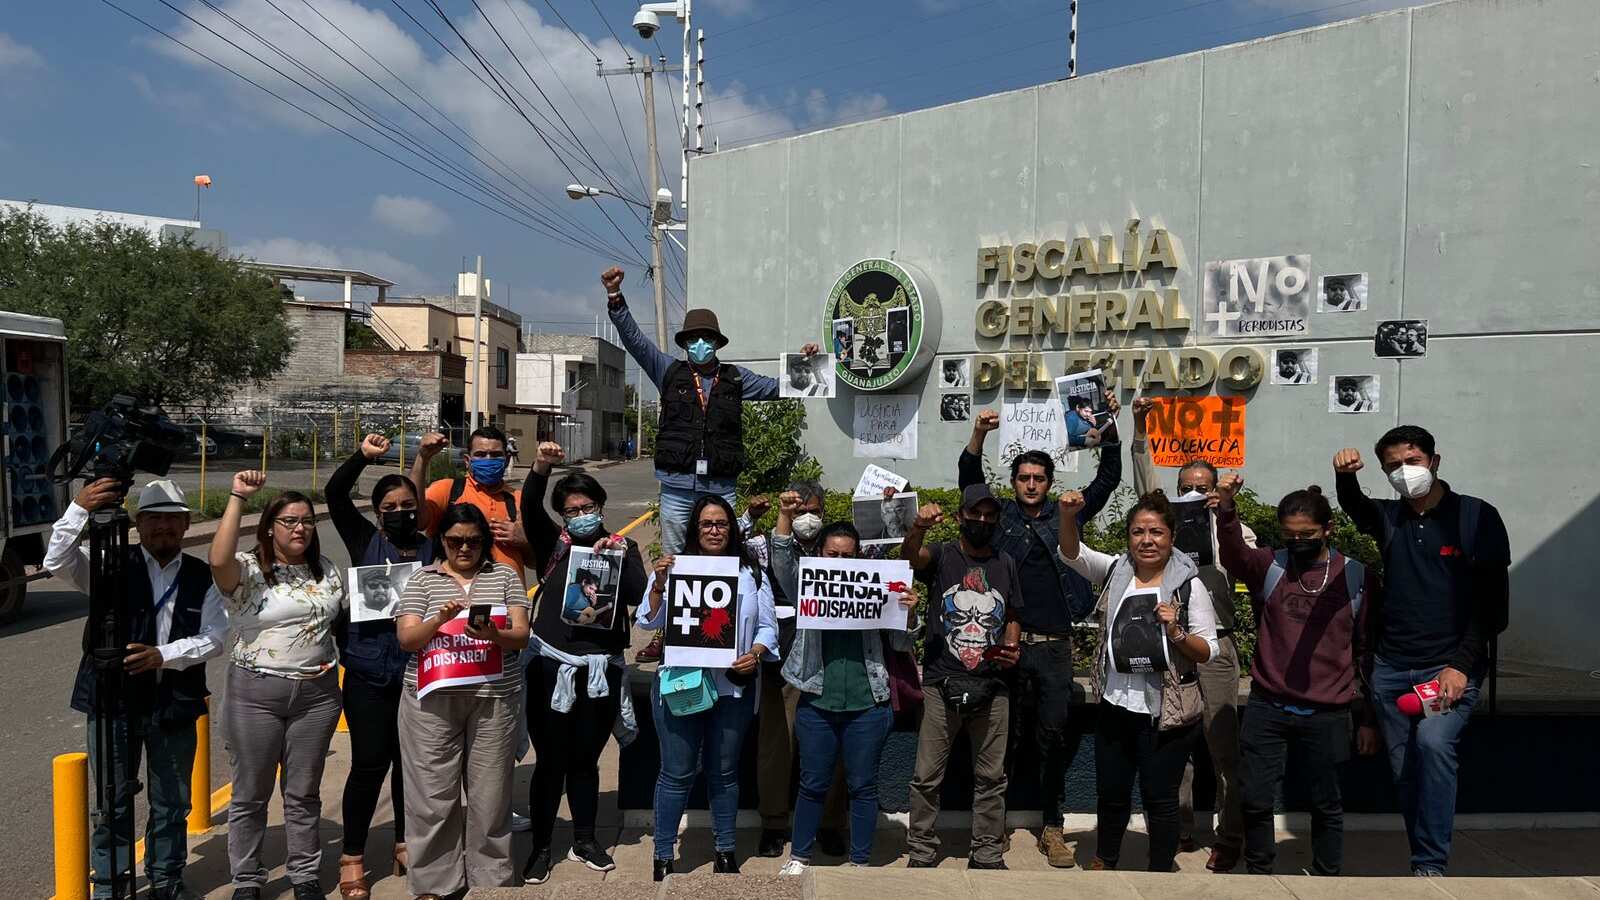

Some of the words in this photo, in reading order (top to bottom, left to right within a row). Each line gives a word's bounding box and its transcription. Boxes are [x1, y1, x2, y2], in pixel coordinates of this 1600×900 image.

[977, 219, 1178, 283] FISCALÍA
[976, 288, 1191, 338] GENERAL
[1238, 319, 1305, 333] PERIODISTAS
[841, 368, 901, 388] GUANAJUATO
[974, 353, 1052, 391] DEL
[1065, 347, 1265, 391] ESTADO
[1069, 382, 1097, 394] JUSTICIA
[1022, 426, 1052, 441] PARA
[1150, 438, 1241, 456] VIOLENCIA
[581, 559, 610, 569] JUSTICIA
[674, 580, 732, 608] NO
[423, 657, 433, 673] NO
[434, 648, 488, 666] DISPAREN
